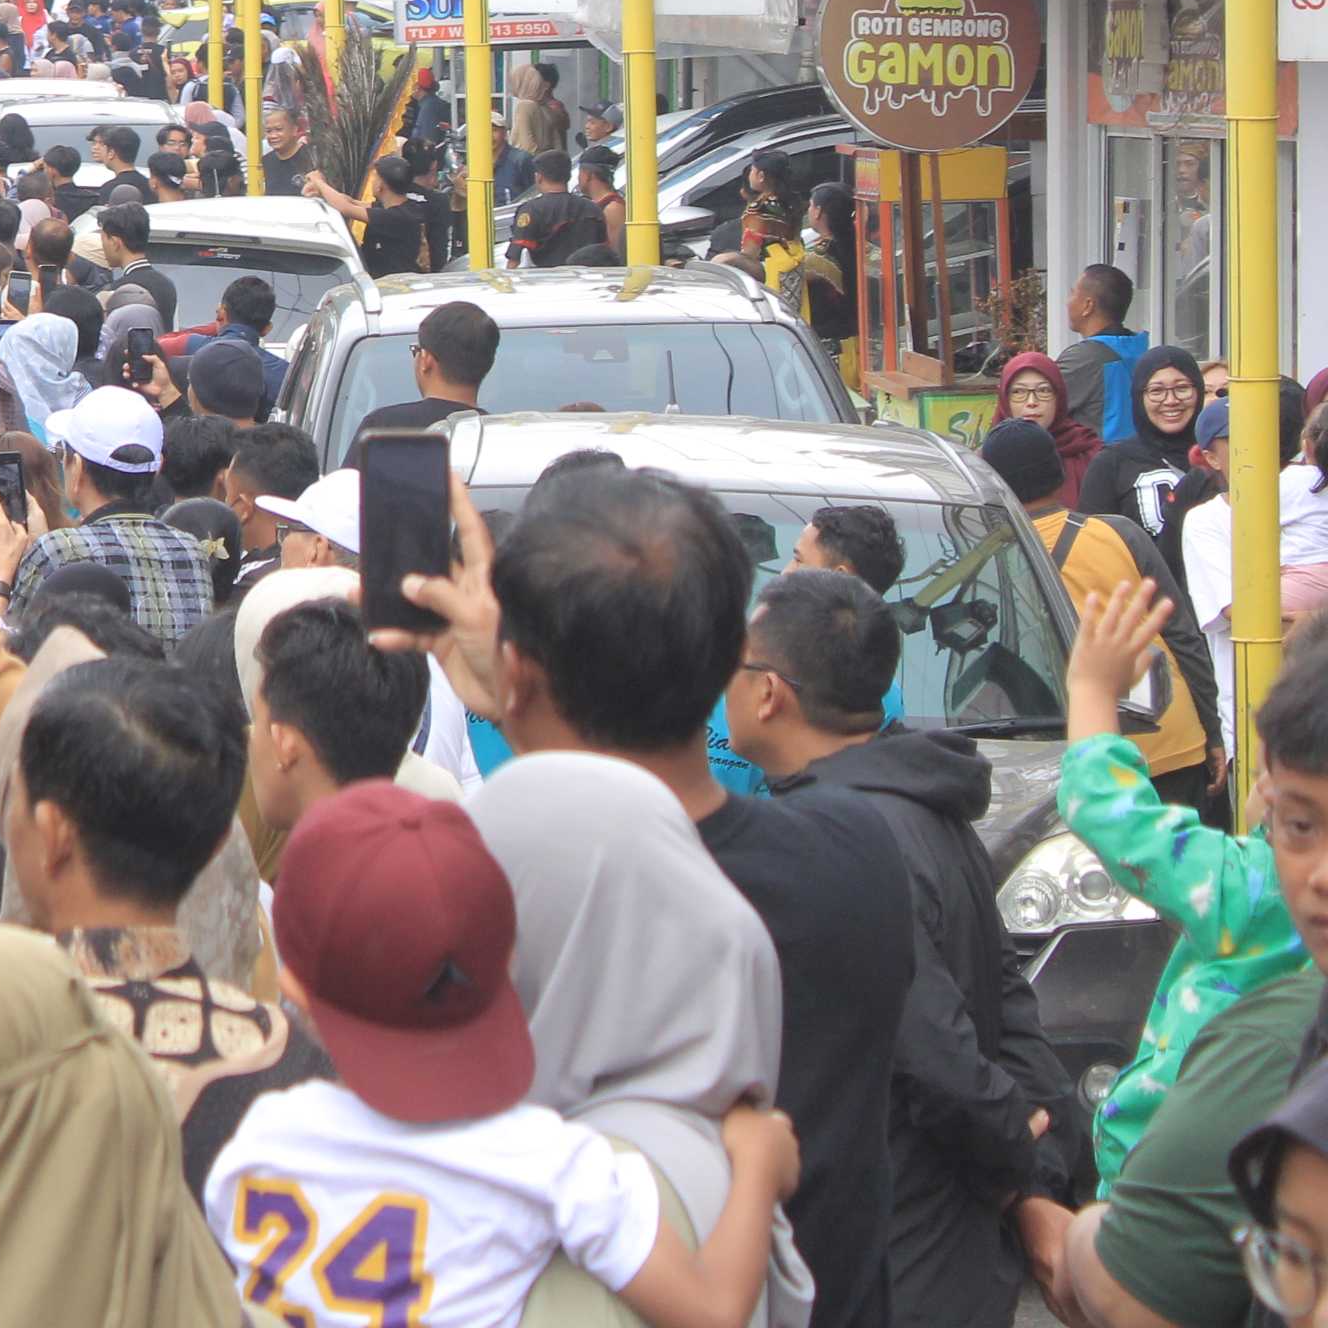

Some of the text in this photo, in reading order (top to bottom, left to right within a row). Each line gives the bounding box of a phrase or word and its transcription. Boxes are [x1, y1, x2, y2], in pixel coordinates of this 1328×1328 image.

[407, 26, 437, 39] TLP
[514, 22, 551, 35] 5950
[857, 16, 1003, 38] ROTI GEMBONG
[232, 1172, 436, 1328] 24
